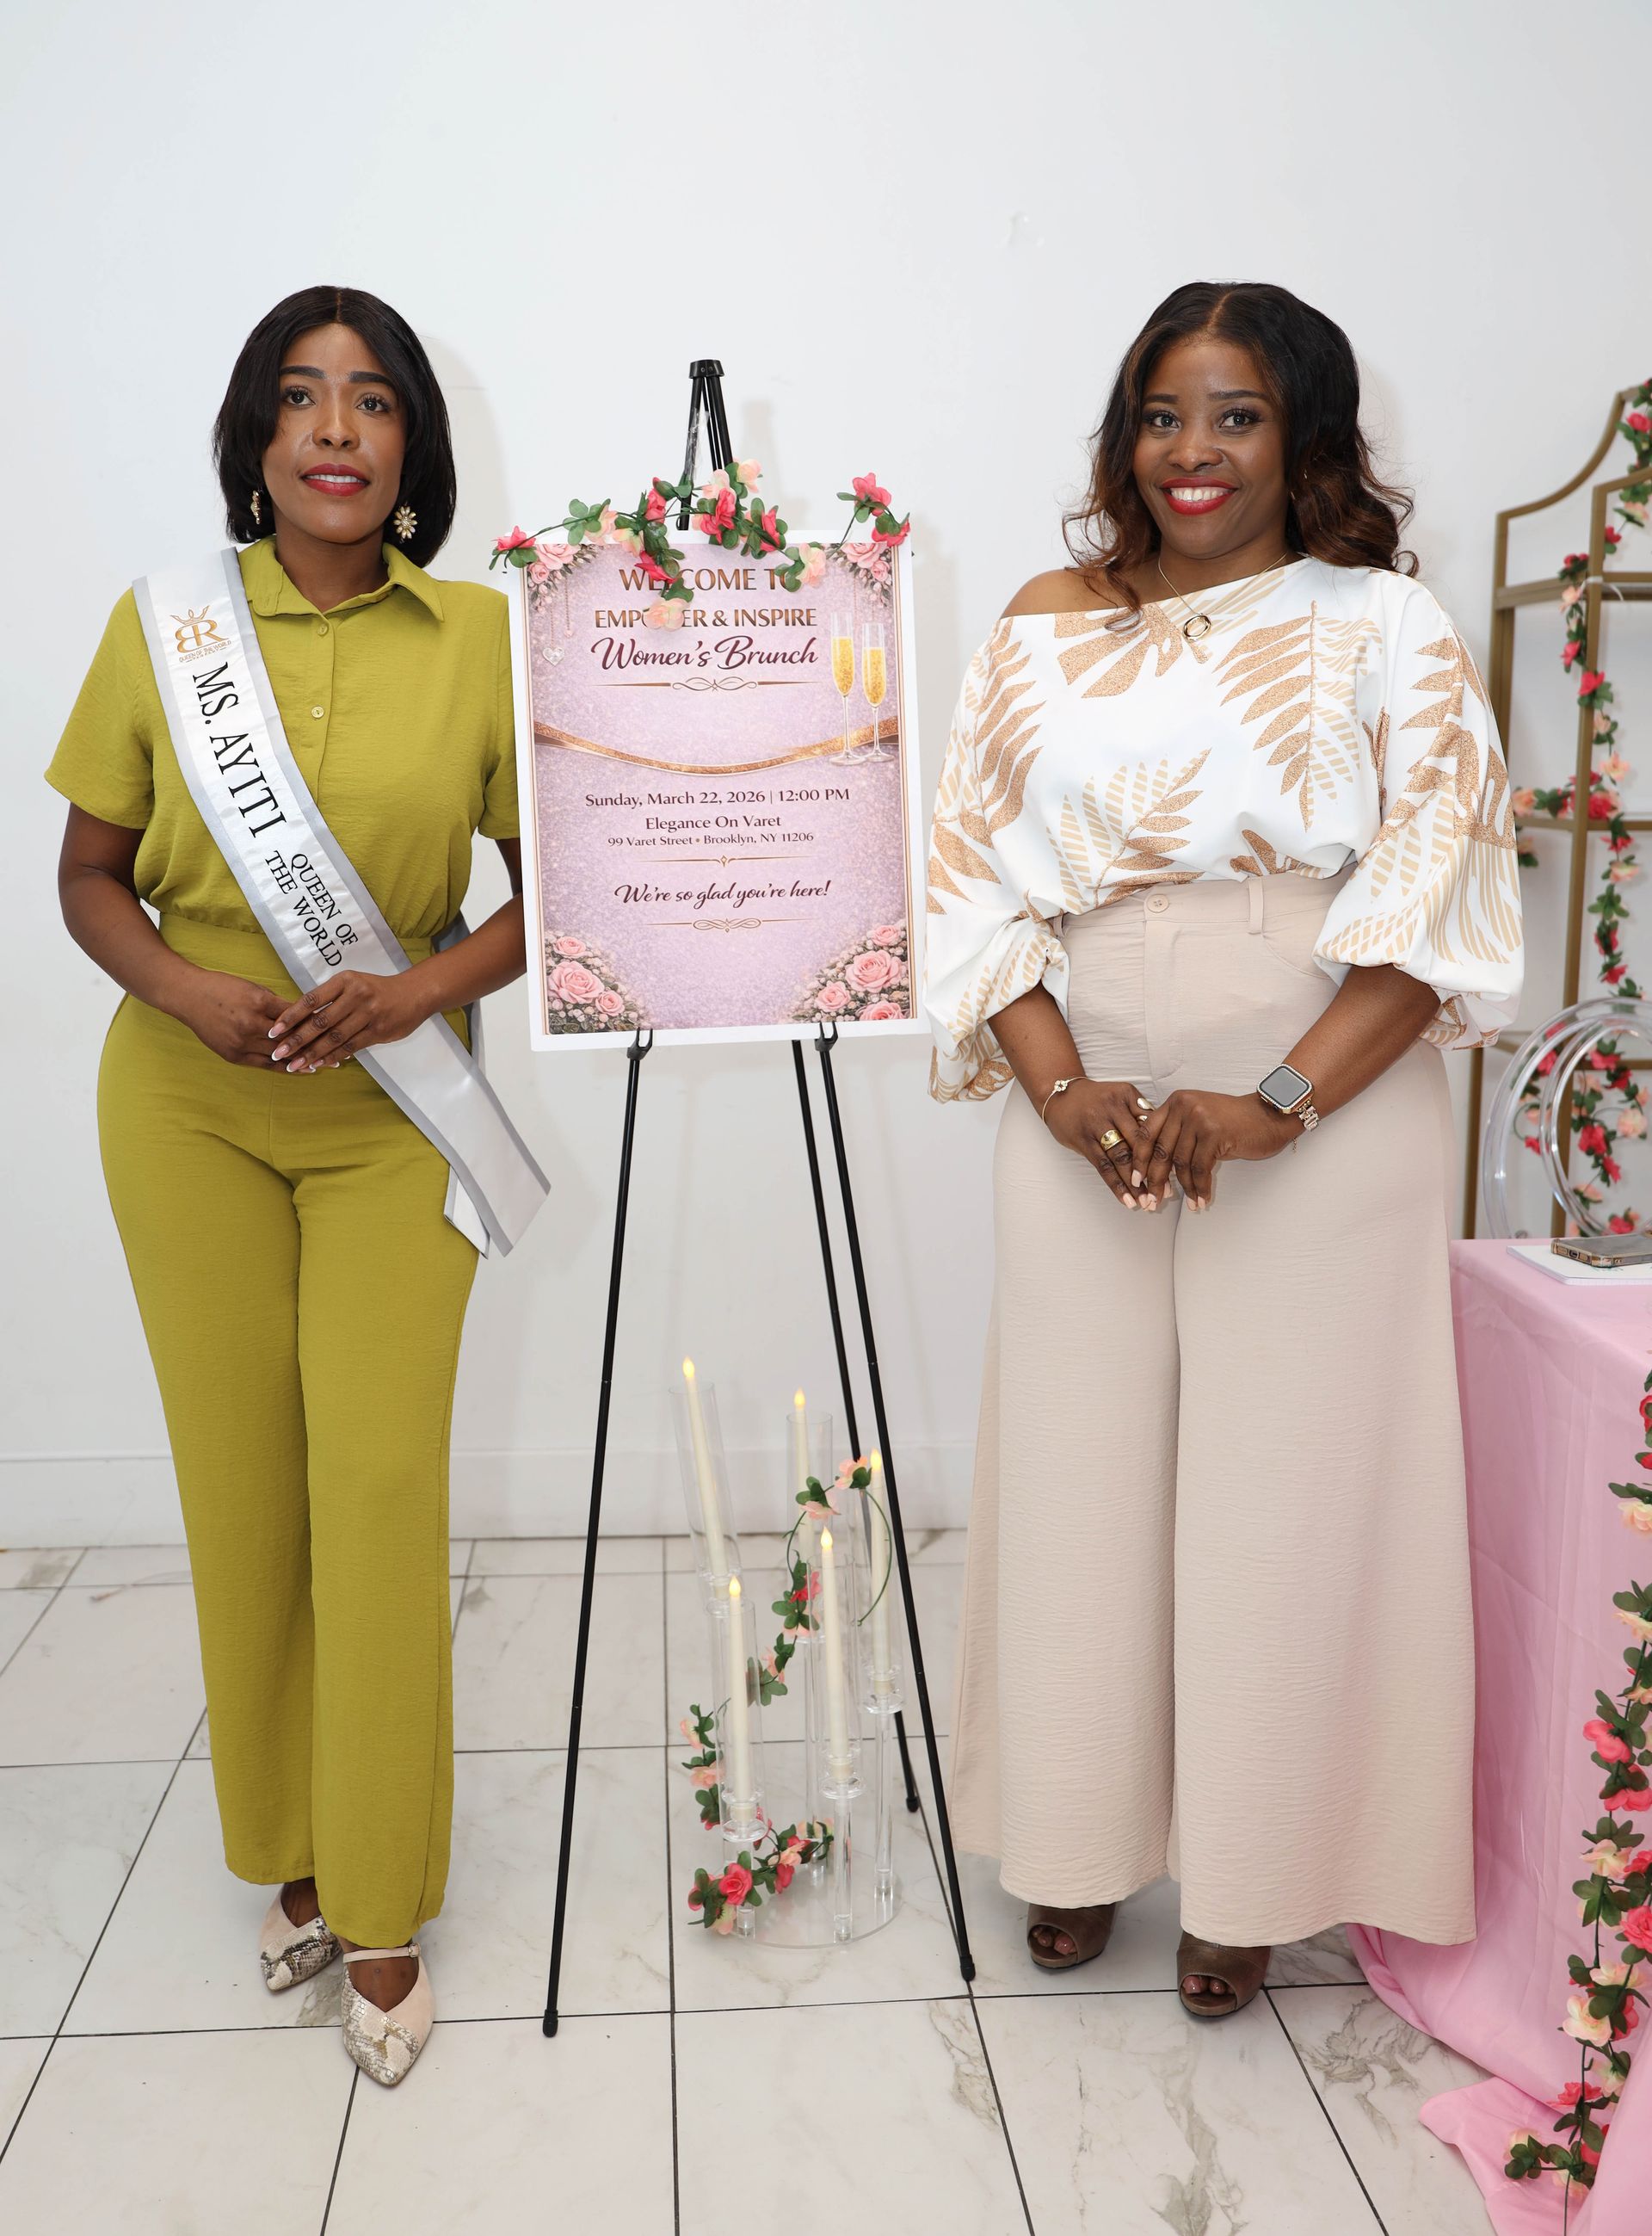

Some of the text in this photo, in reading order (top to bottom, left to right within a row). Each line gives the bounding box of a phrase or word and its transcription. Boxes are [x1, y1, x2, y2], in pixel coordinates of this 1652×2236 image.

[619, 567, 757, 591] WECOME
[595, 608, 817, 629] EMPER & INSPIRE
[590, 635, 819, 670] Women's Brunch
[193, 661, 287, 838] MS. AYITI
[585, 793, 644, 810] Sunday,
[647, 791, 695, 806] March
[699, 791, 723, 806] 22,
[726, 790, 766, 804] 2026
[778, 788, 821, 802] 12:00
[824, 788, 851, 801] PM
[645, 814, 782, 833] Elegance On Varet
[607, 837, 625, 847] 99
[626, 837, 656, 847] Varet
[659, 835, 693, 846] Street
[703, 833, 757, 847] Brooklyn,
[761, 832, 778, 843] NY
[781, 831, 815, 843] 11206
[265, 849, 342, 967] THE WORLD
[291, 853, 359, 946] QUEEN OF
[614, 880, 832, 910] We're so glad you're here!
